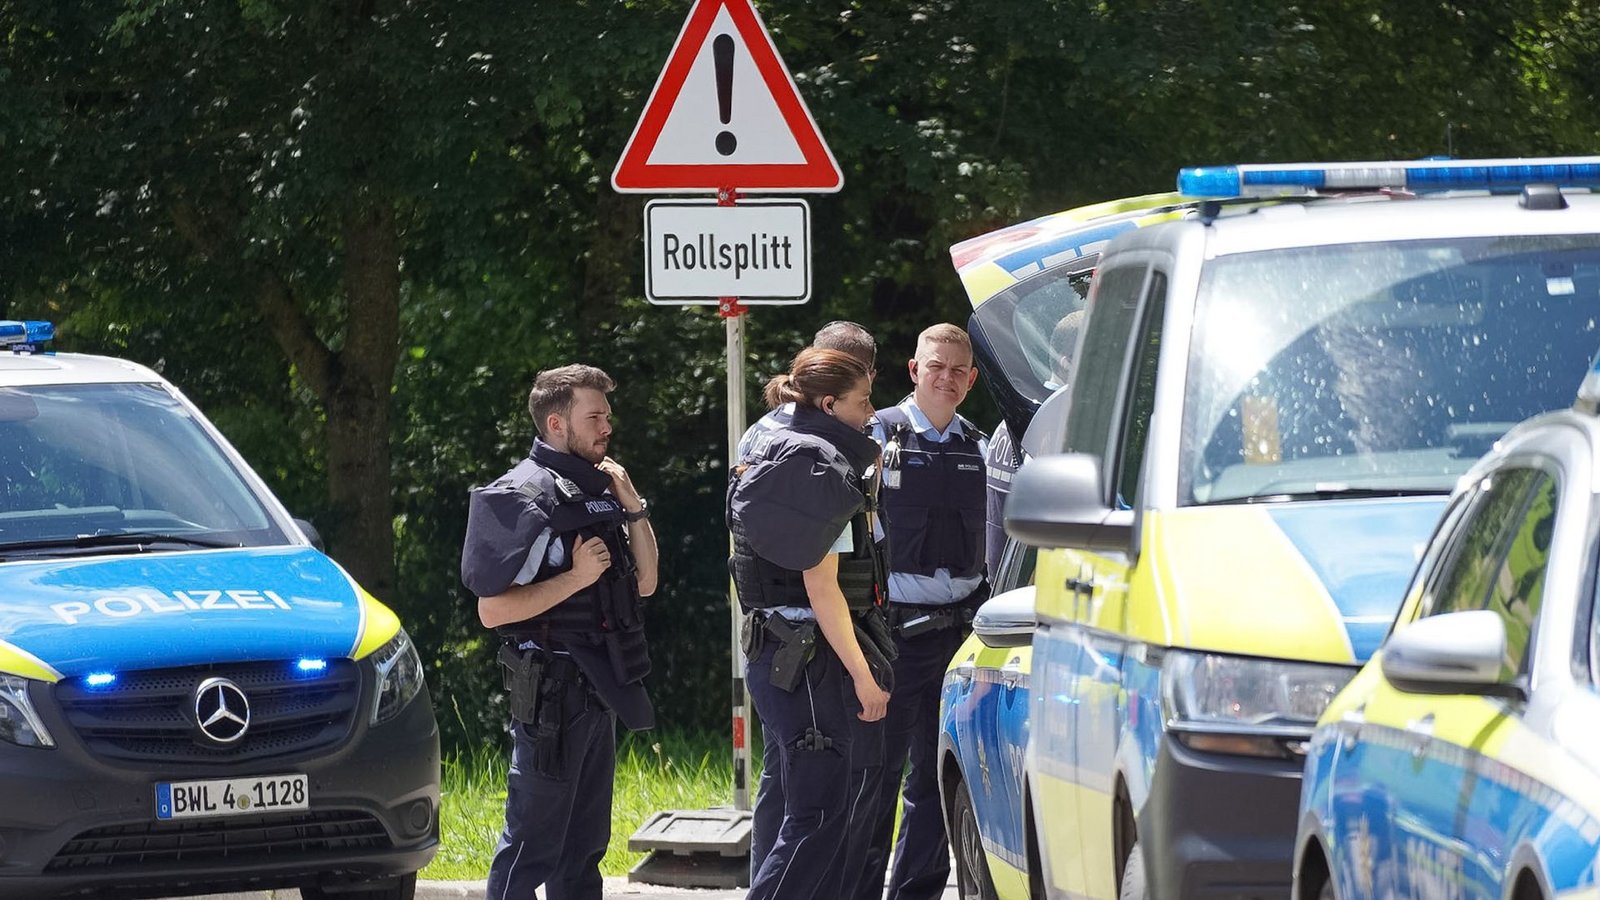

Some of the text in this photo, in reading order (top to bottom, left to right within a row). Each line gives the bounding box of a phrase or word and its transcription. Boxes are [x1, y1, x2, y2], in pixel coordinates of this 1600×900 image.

[663, 232, 792, 280] Rollsplitt
[50, 589, 293, 625] POLIZEI
[173, 785, 217, 813] BWL
[222, 783, 236, 810] 4
[252, 778, 305, 808] 1128
